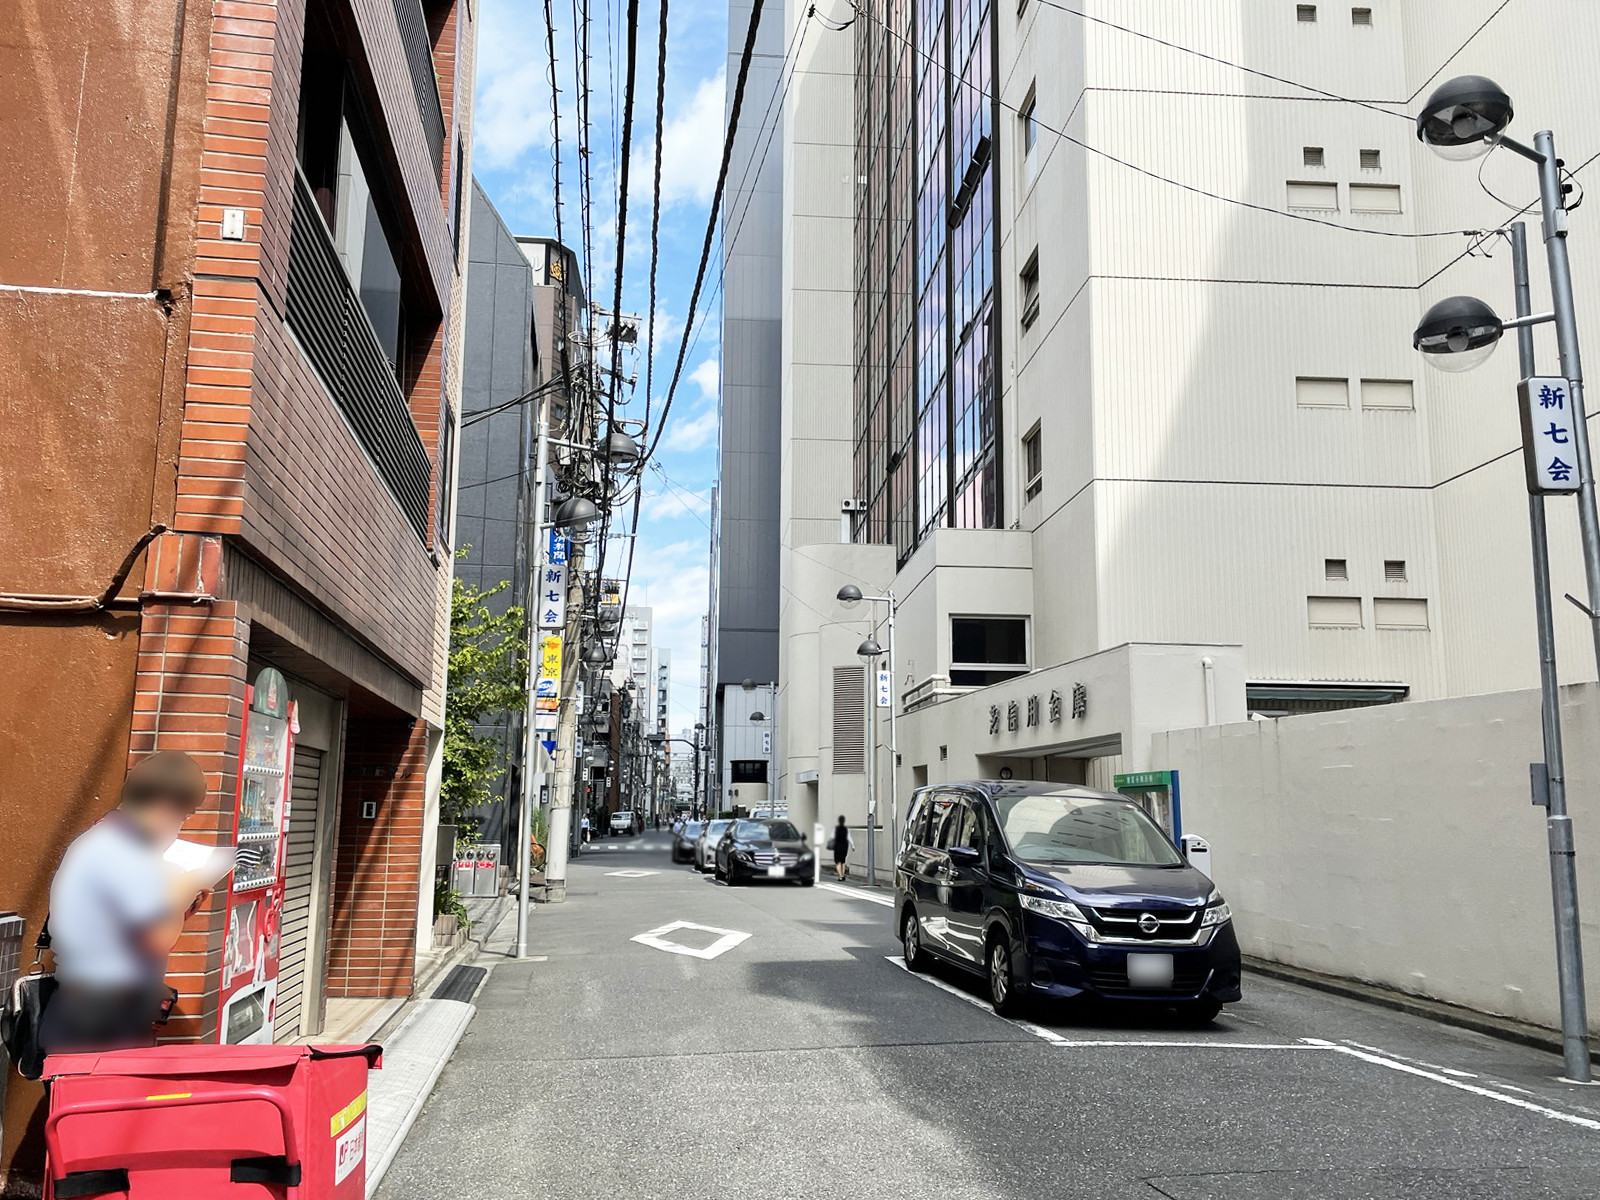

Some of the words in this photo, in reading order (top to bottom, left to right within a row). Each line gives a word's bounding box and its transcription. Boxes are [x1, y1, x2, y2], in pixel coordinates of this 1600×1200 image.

[1538, 384, 1573, 482] 新七会
[544, 569, 562, 623] 新七会
[879, 673, 889, 705] 新七会
[989, 681, 1088, 735] 芝信用金庫
